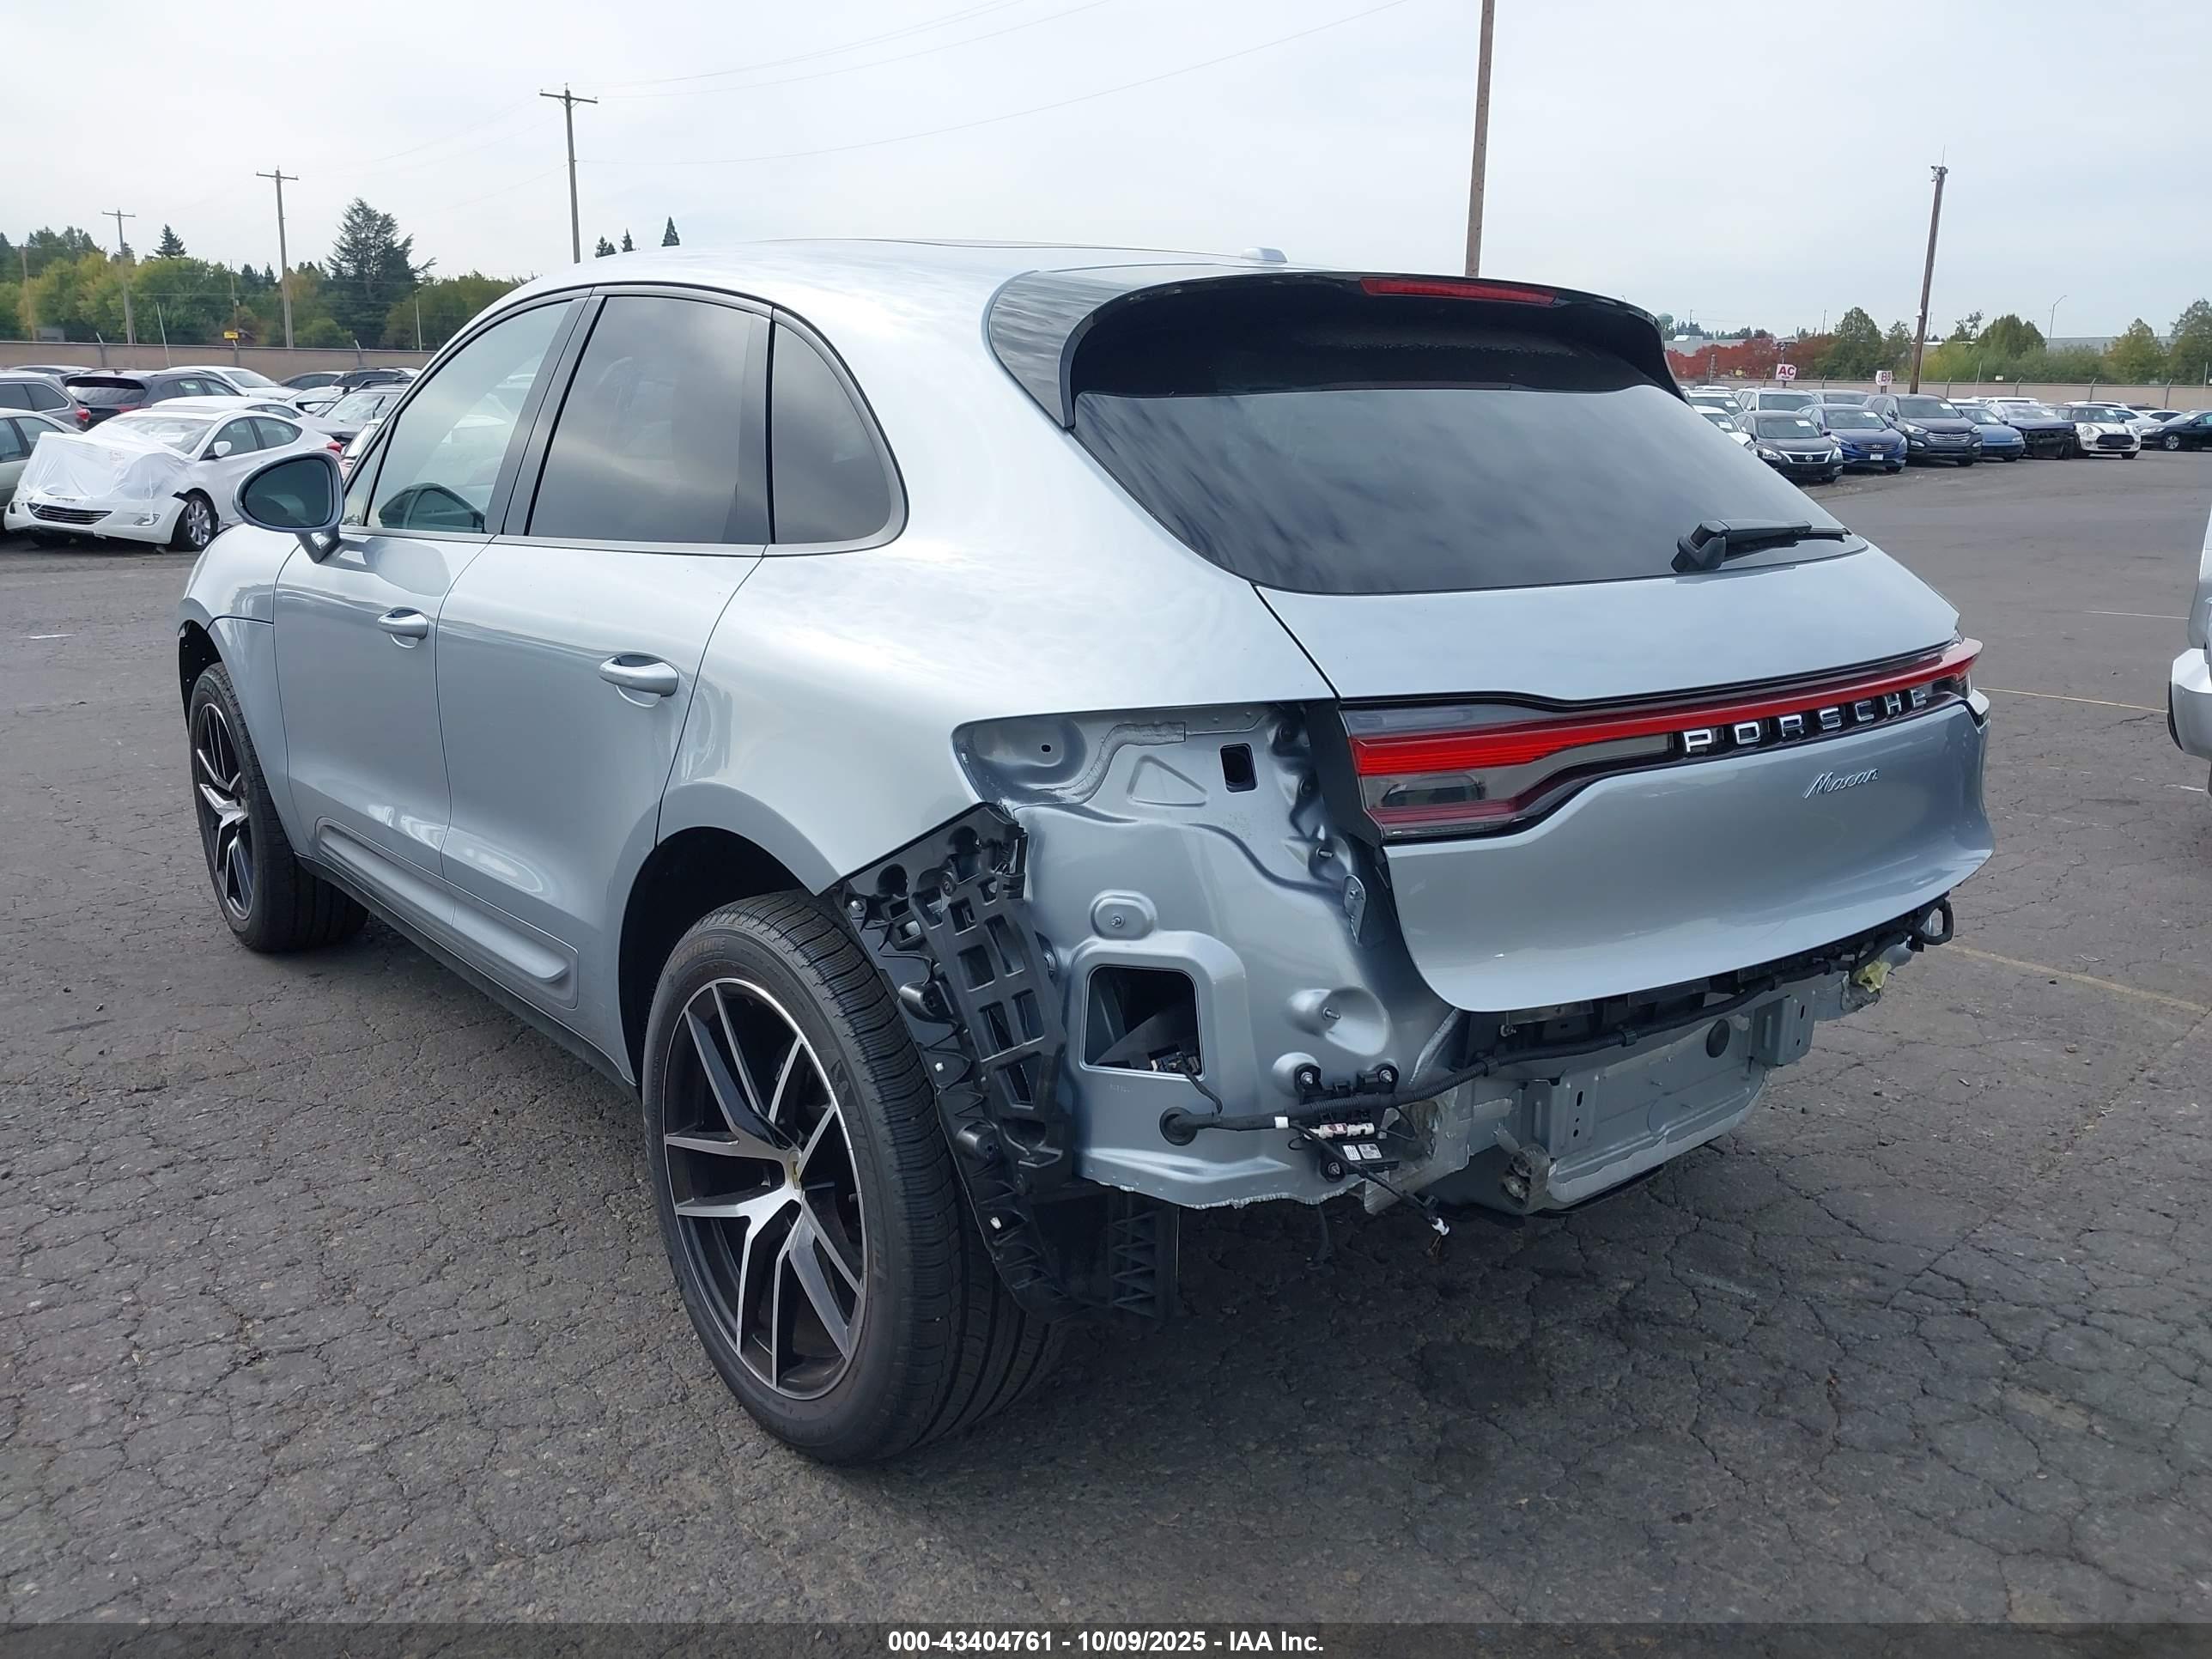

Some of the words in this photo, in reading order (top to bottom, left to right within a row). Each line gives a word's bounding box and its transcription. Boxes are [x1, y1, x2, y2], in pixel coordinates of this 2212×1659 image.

[1778, 366, 1795, 376] AC
[1683, 689, 1928, 753] PORSCHE
[1802, 768, 1879, 799] Macan
